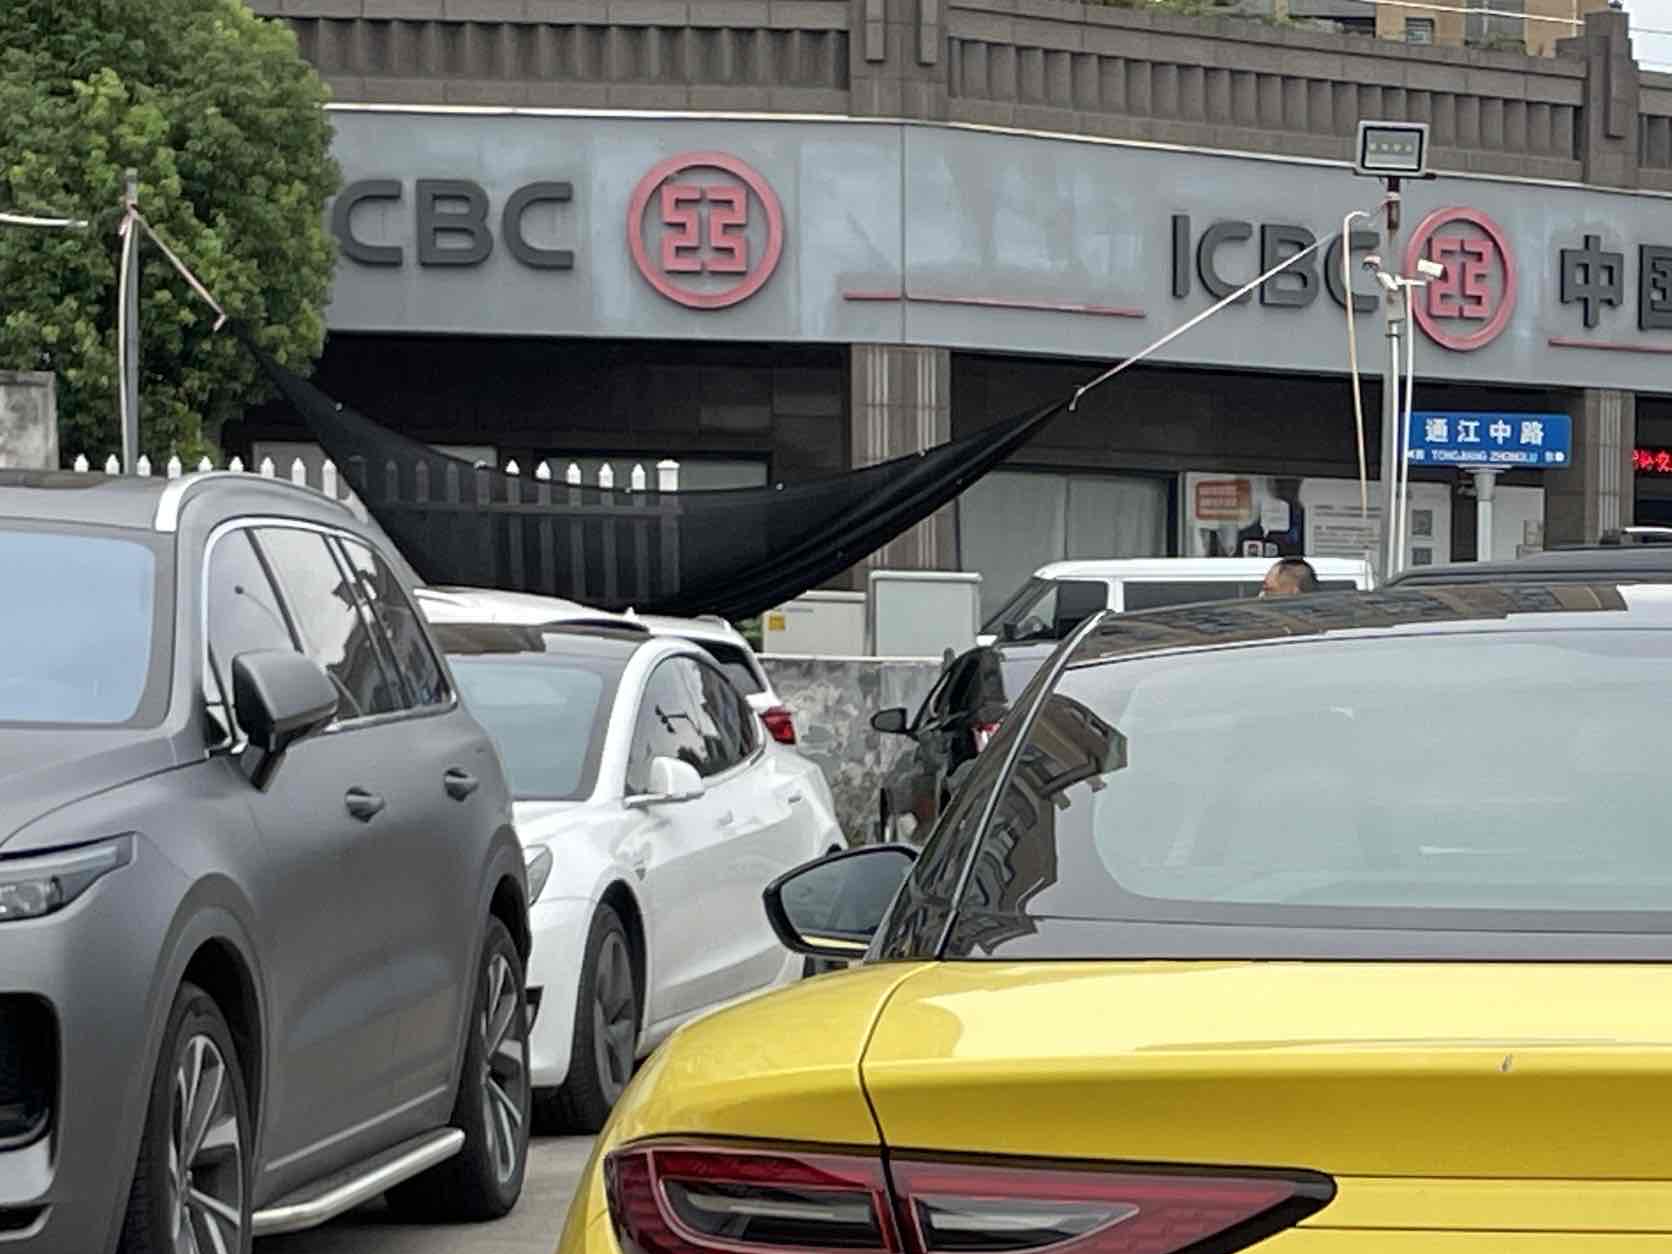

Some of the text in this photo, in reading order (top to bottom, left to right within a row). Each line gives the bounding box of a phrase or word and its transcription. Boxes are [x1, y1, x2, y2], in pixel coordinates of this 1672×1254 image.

[331, 178, 575, 270] CBC
[1170, 213, 1382, 314] ICBC
[1424, 417, 1545, 446] 通江中路
